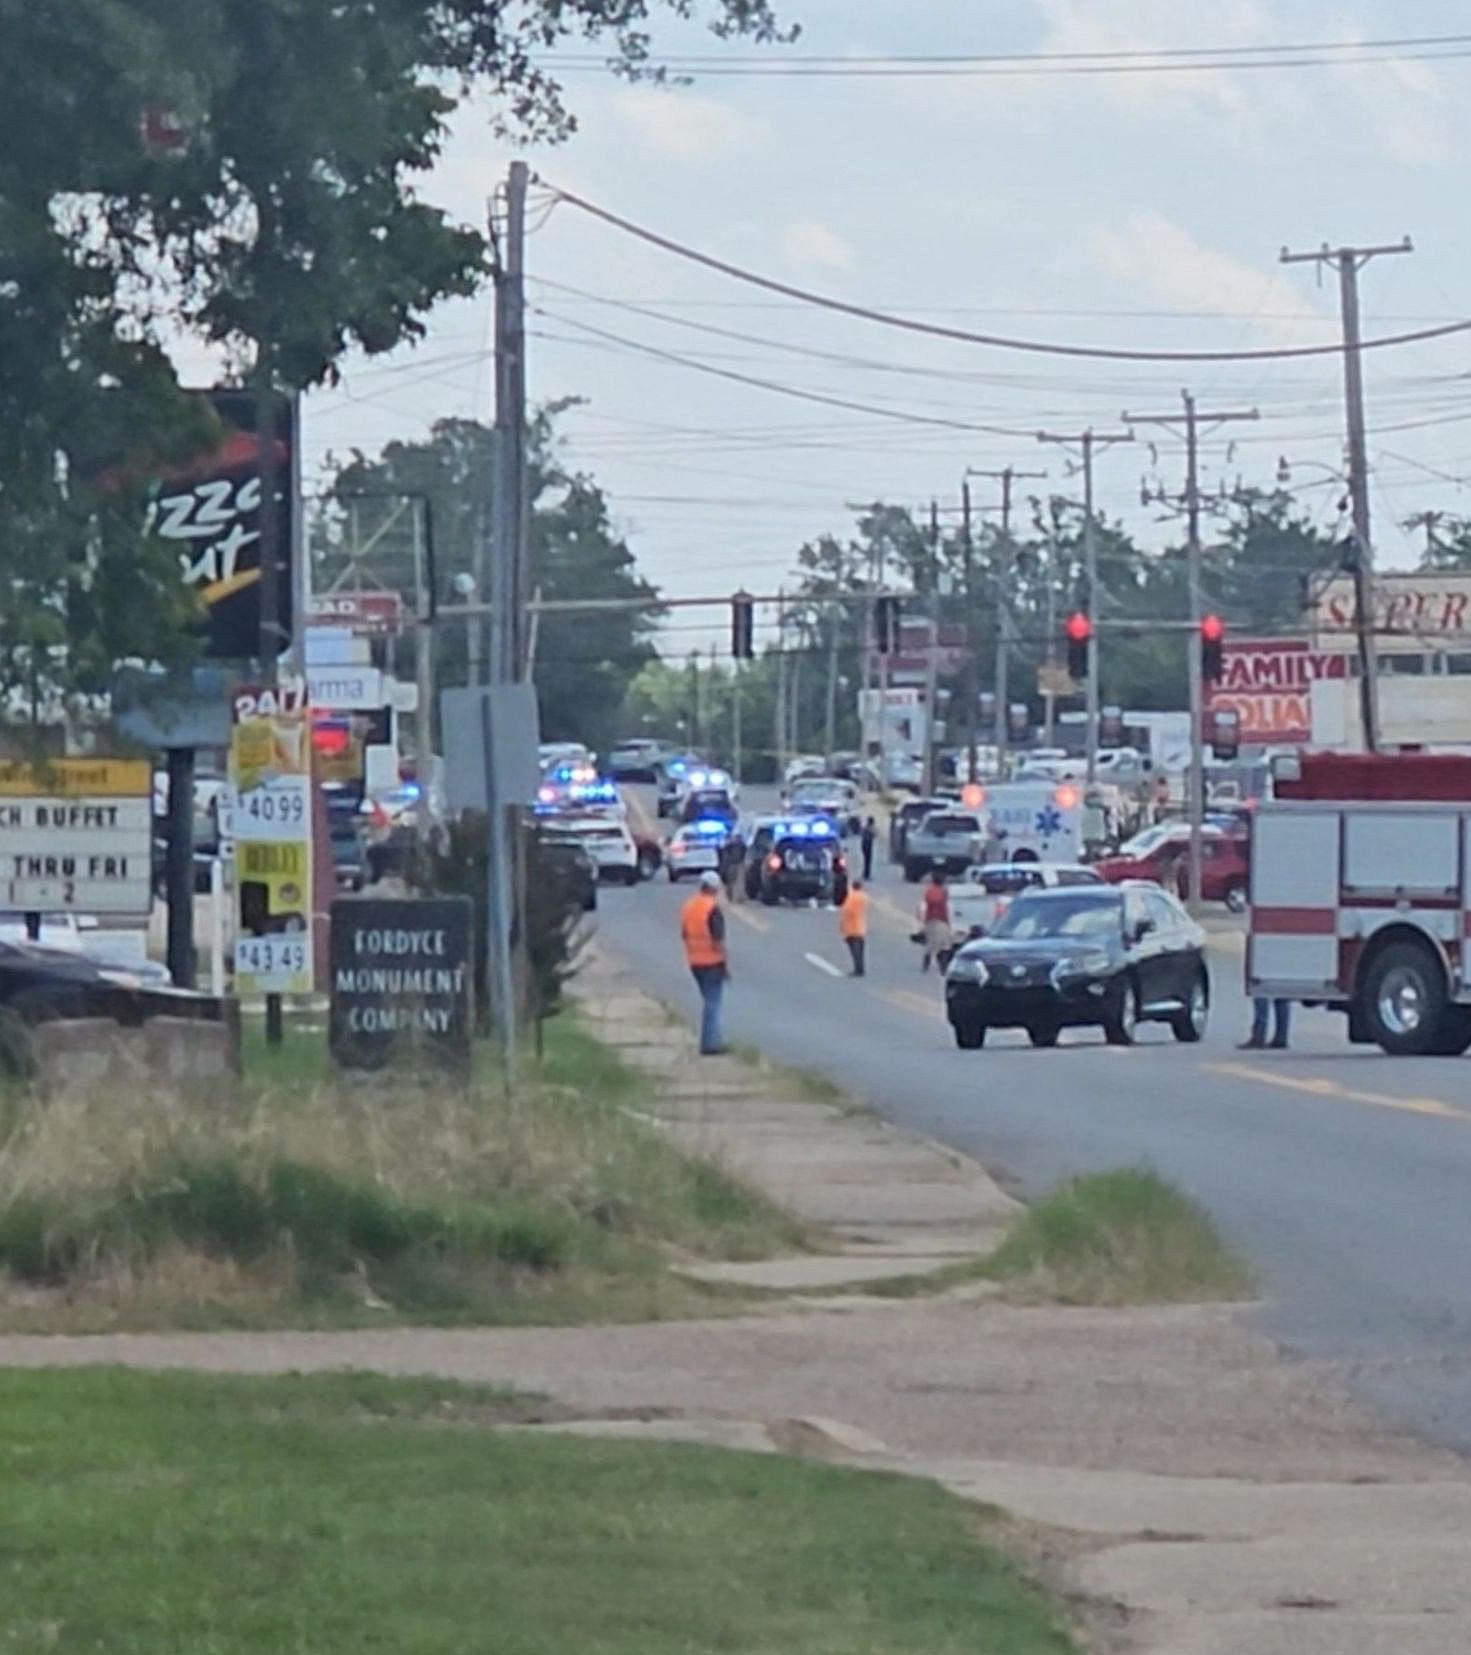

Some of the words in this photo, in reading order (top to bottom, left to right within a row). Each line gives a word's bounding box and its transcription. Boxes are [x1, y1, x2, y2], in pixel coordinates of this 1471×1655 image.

[177, 523, 263, 585] ut
[1328, 591, 1470, 631] SPER
[36, 806, 118, 827] BUFFET
[13, 855, 76, 878] THRU
[88, 855, 127, 879] FRI
[354, 929, 447, 955] FORDYCE
[336, 966, 464, 993] MONUMENT
[350, 1006, 451, 1033] COMNY
